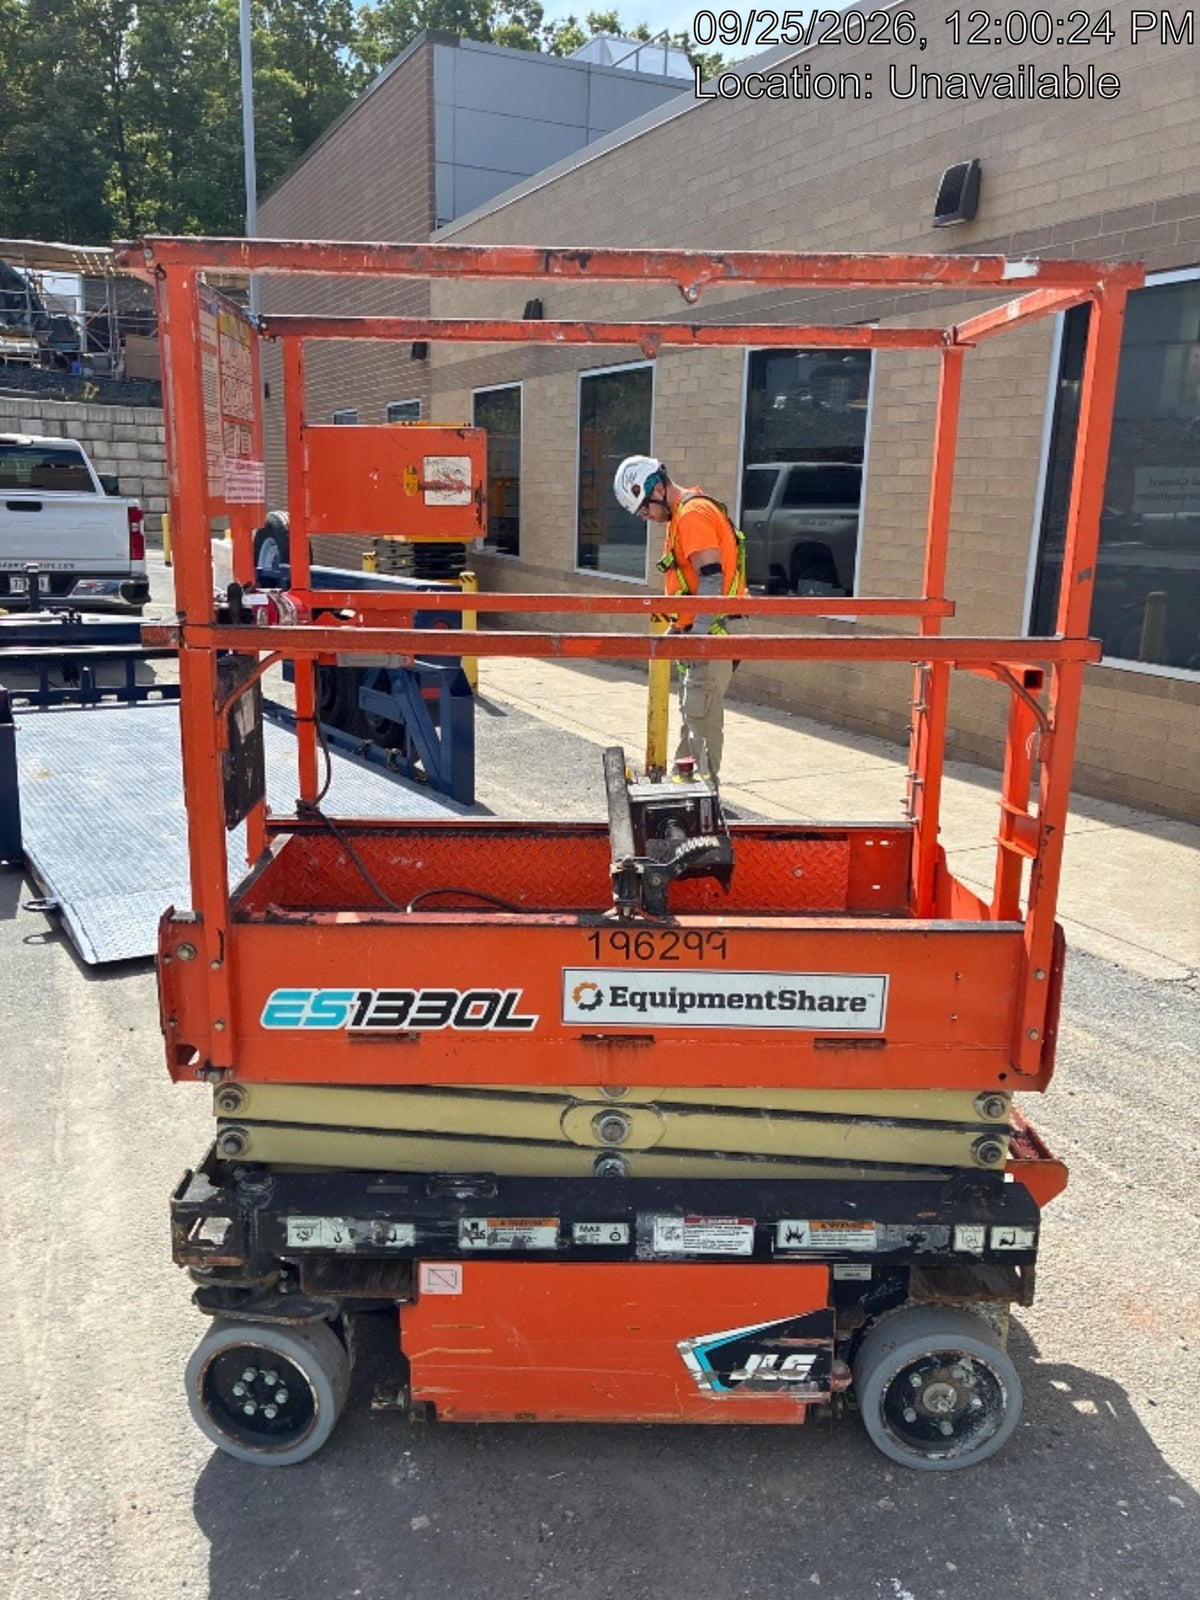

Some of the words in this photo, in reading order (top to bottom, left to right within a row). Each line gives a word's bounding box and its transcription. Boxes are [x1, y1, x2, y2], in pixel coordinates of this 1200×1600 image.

[588, 930, 727, 960] 196299
[261, 989, 538, 1030] ES1330L
[609, 986, 867, 1014] EquipmentShare
